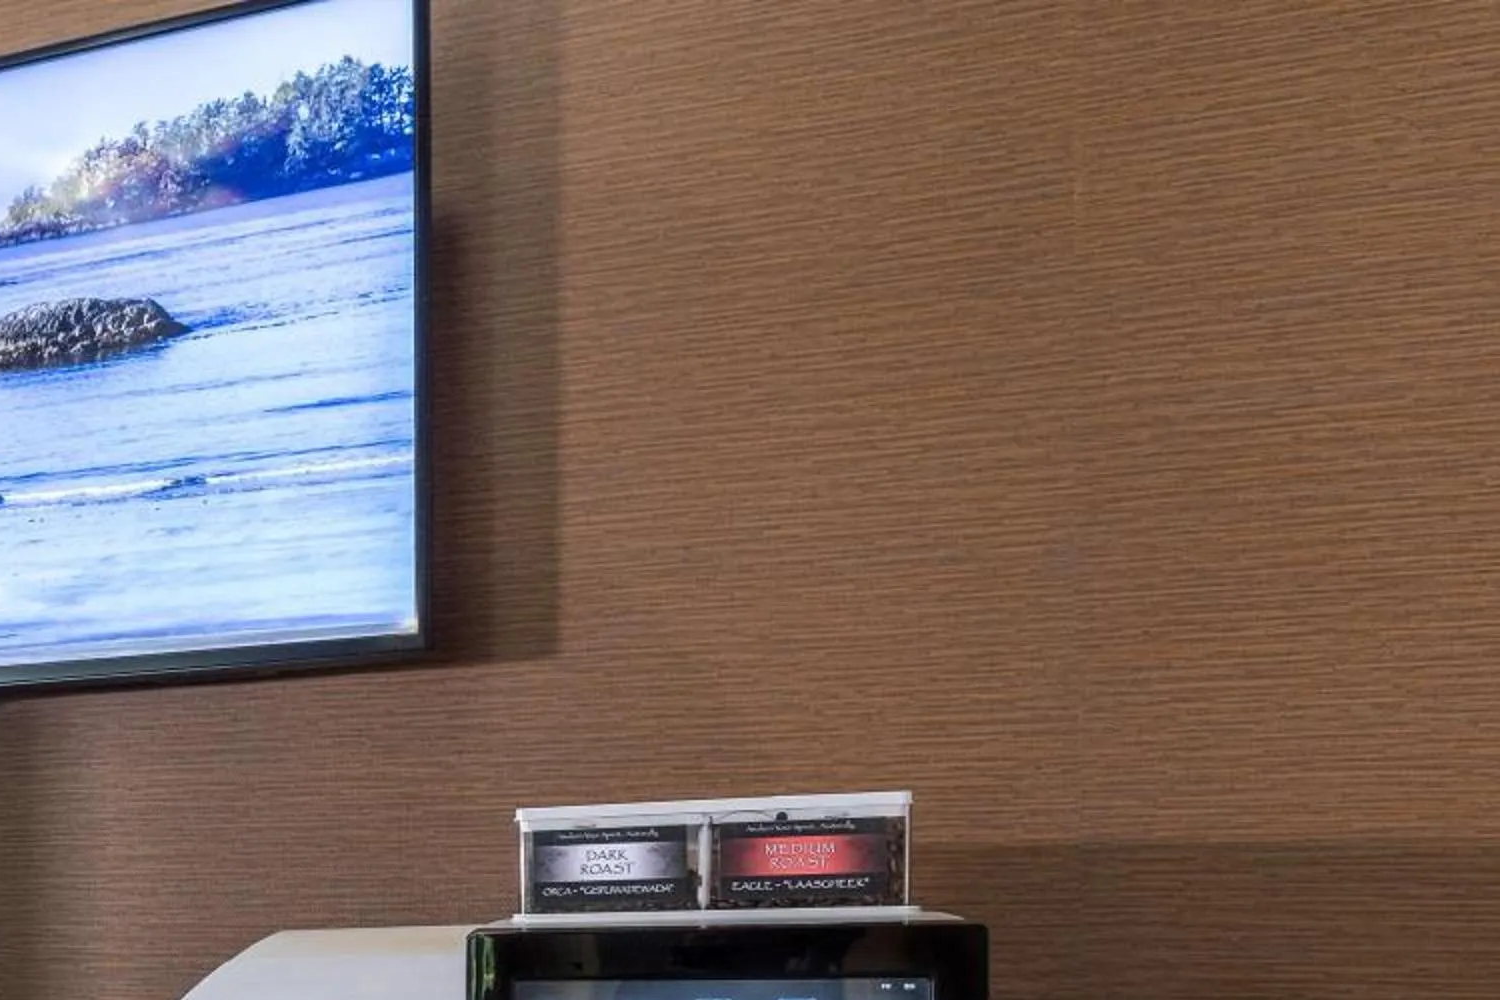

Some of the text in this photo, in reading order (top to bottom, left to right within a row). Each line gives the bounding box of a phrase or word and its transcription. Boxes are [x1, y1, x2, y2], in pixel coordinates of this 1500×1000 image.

[585, 849, 628, 861] DARK
[765, 842, 835, 856] MEDIUM
[580, 862, 633, 876] ROAST
